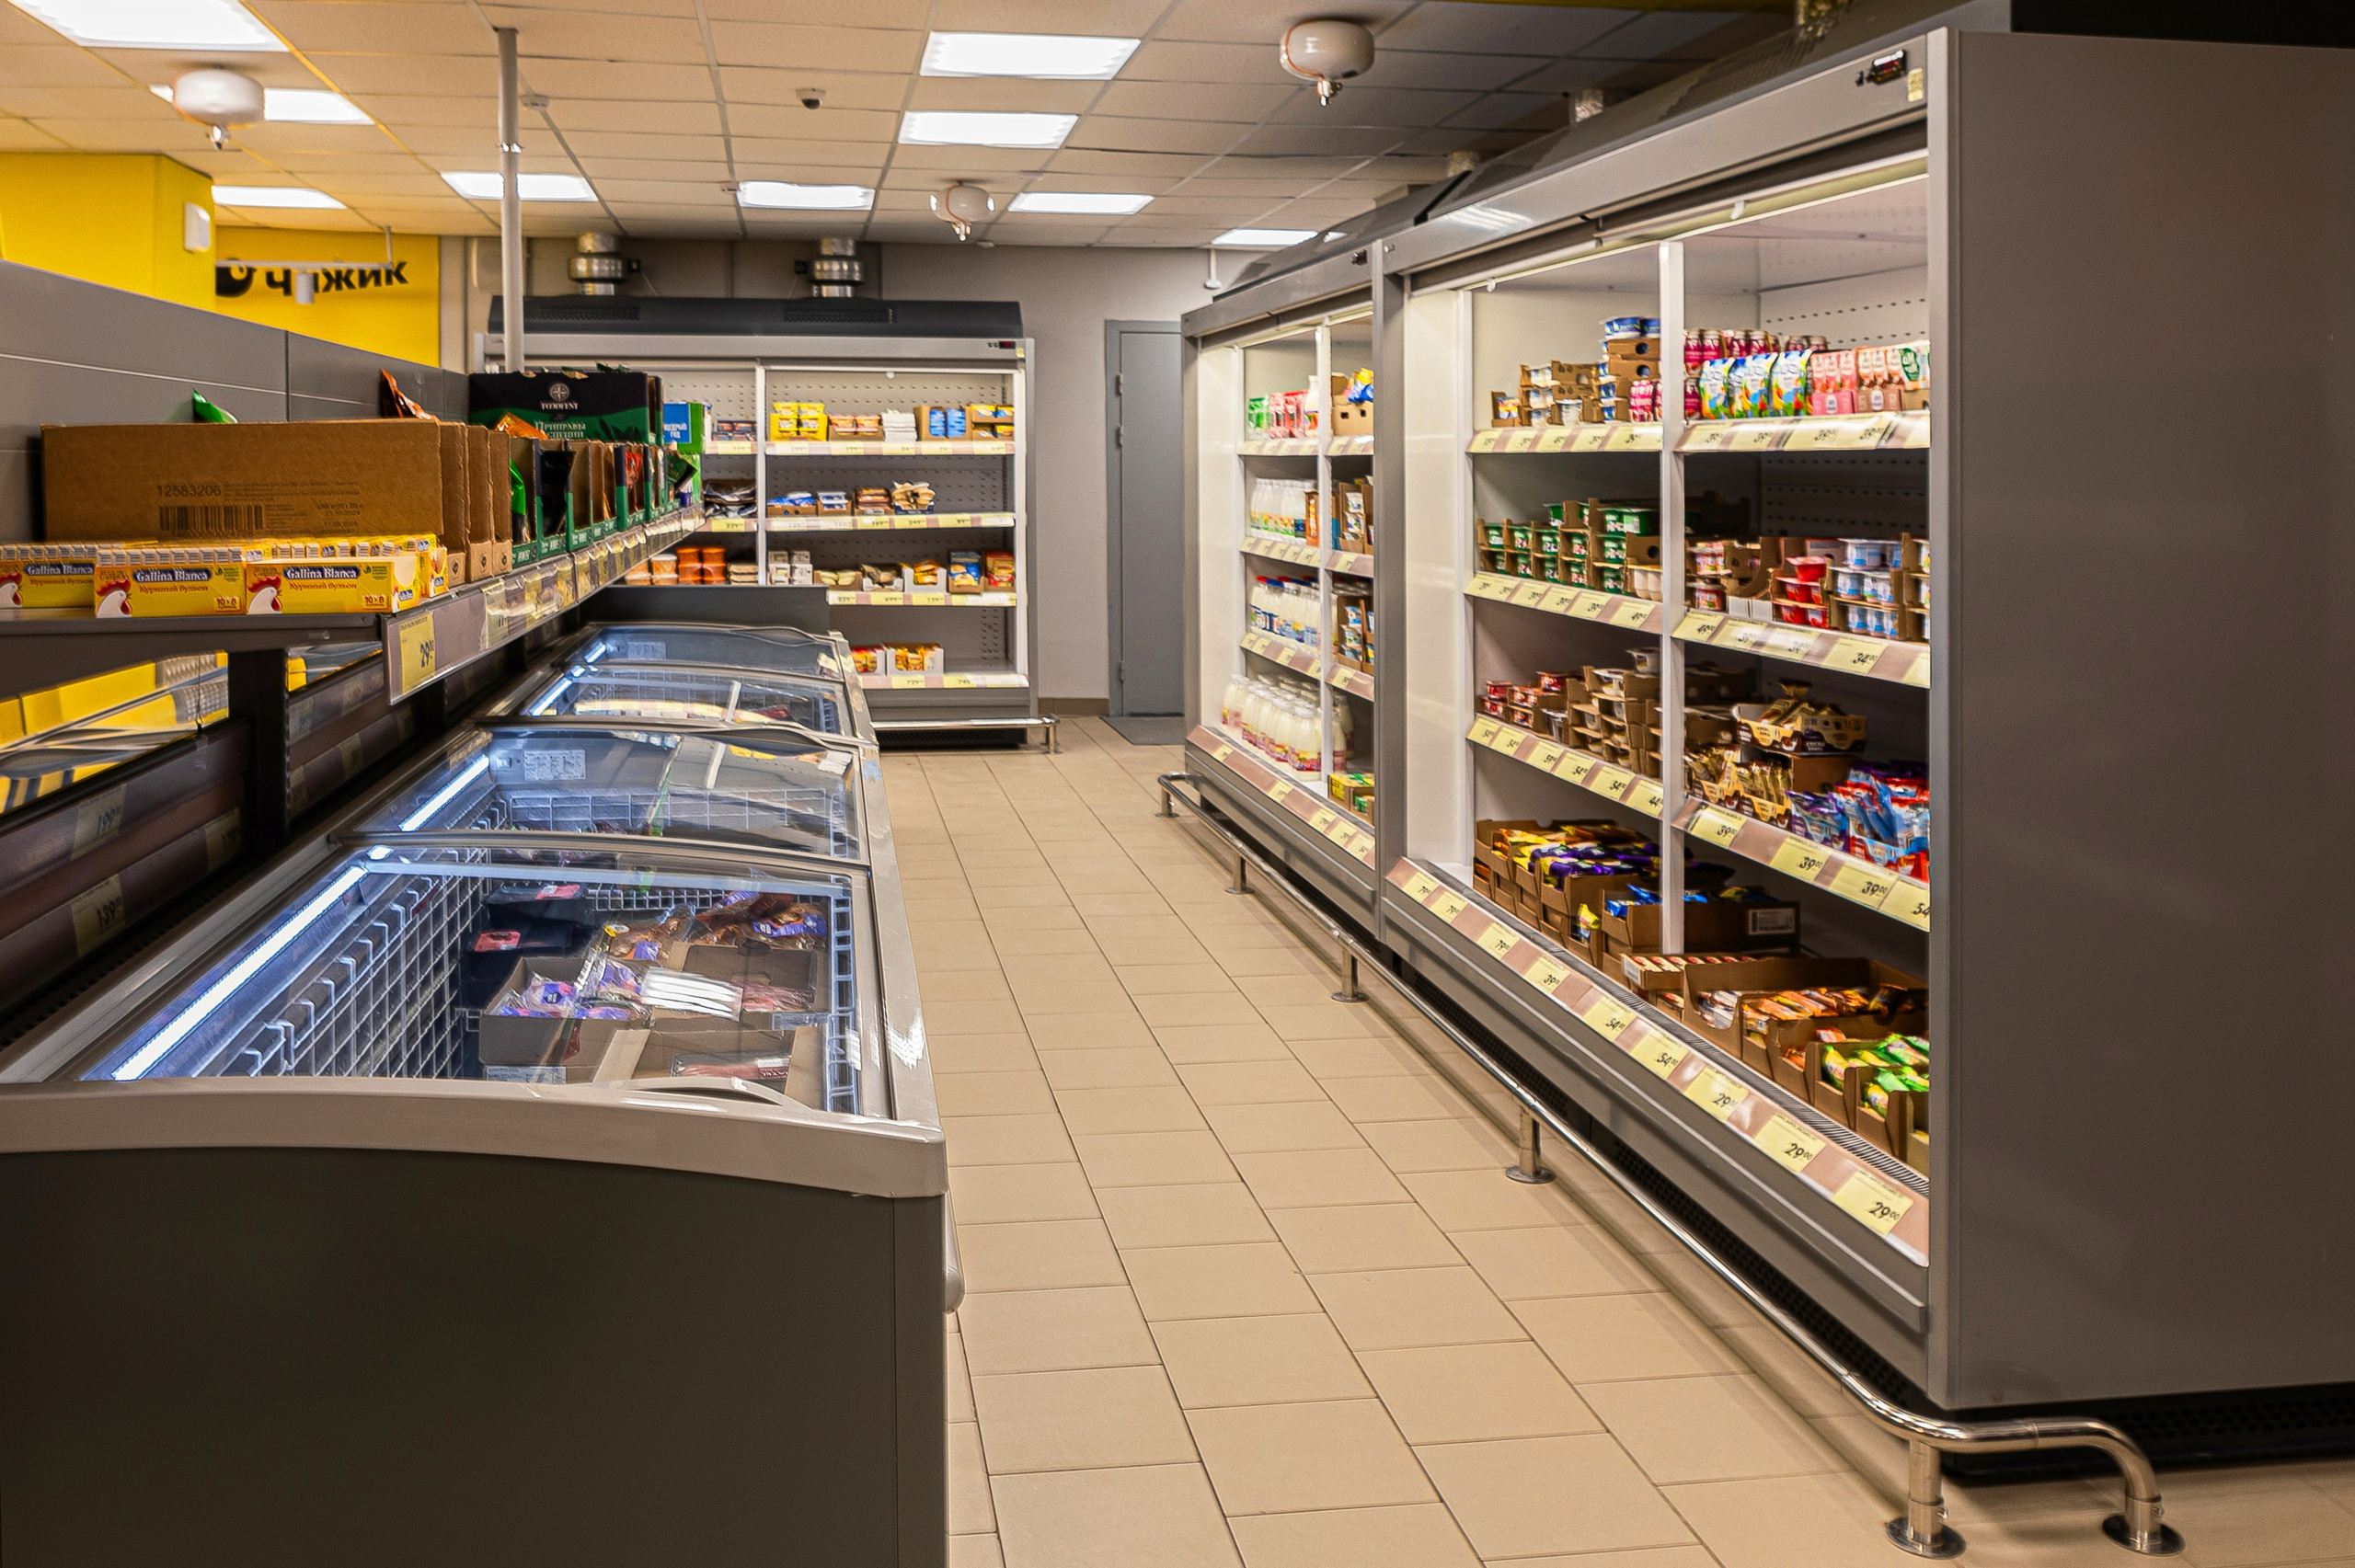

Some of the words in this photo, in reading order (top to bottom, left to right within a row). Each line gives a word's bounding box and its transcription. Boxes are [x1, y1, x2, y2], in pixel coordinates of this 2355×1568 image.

[28, 565, 62, 575] Gallina
[136, 571, 173, 582] Gallina
[174, 570, 209, 581] Blanca
[286, 568, 323, 579] Gallina
[324, 567, 358, 578] Blanca
